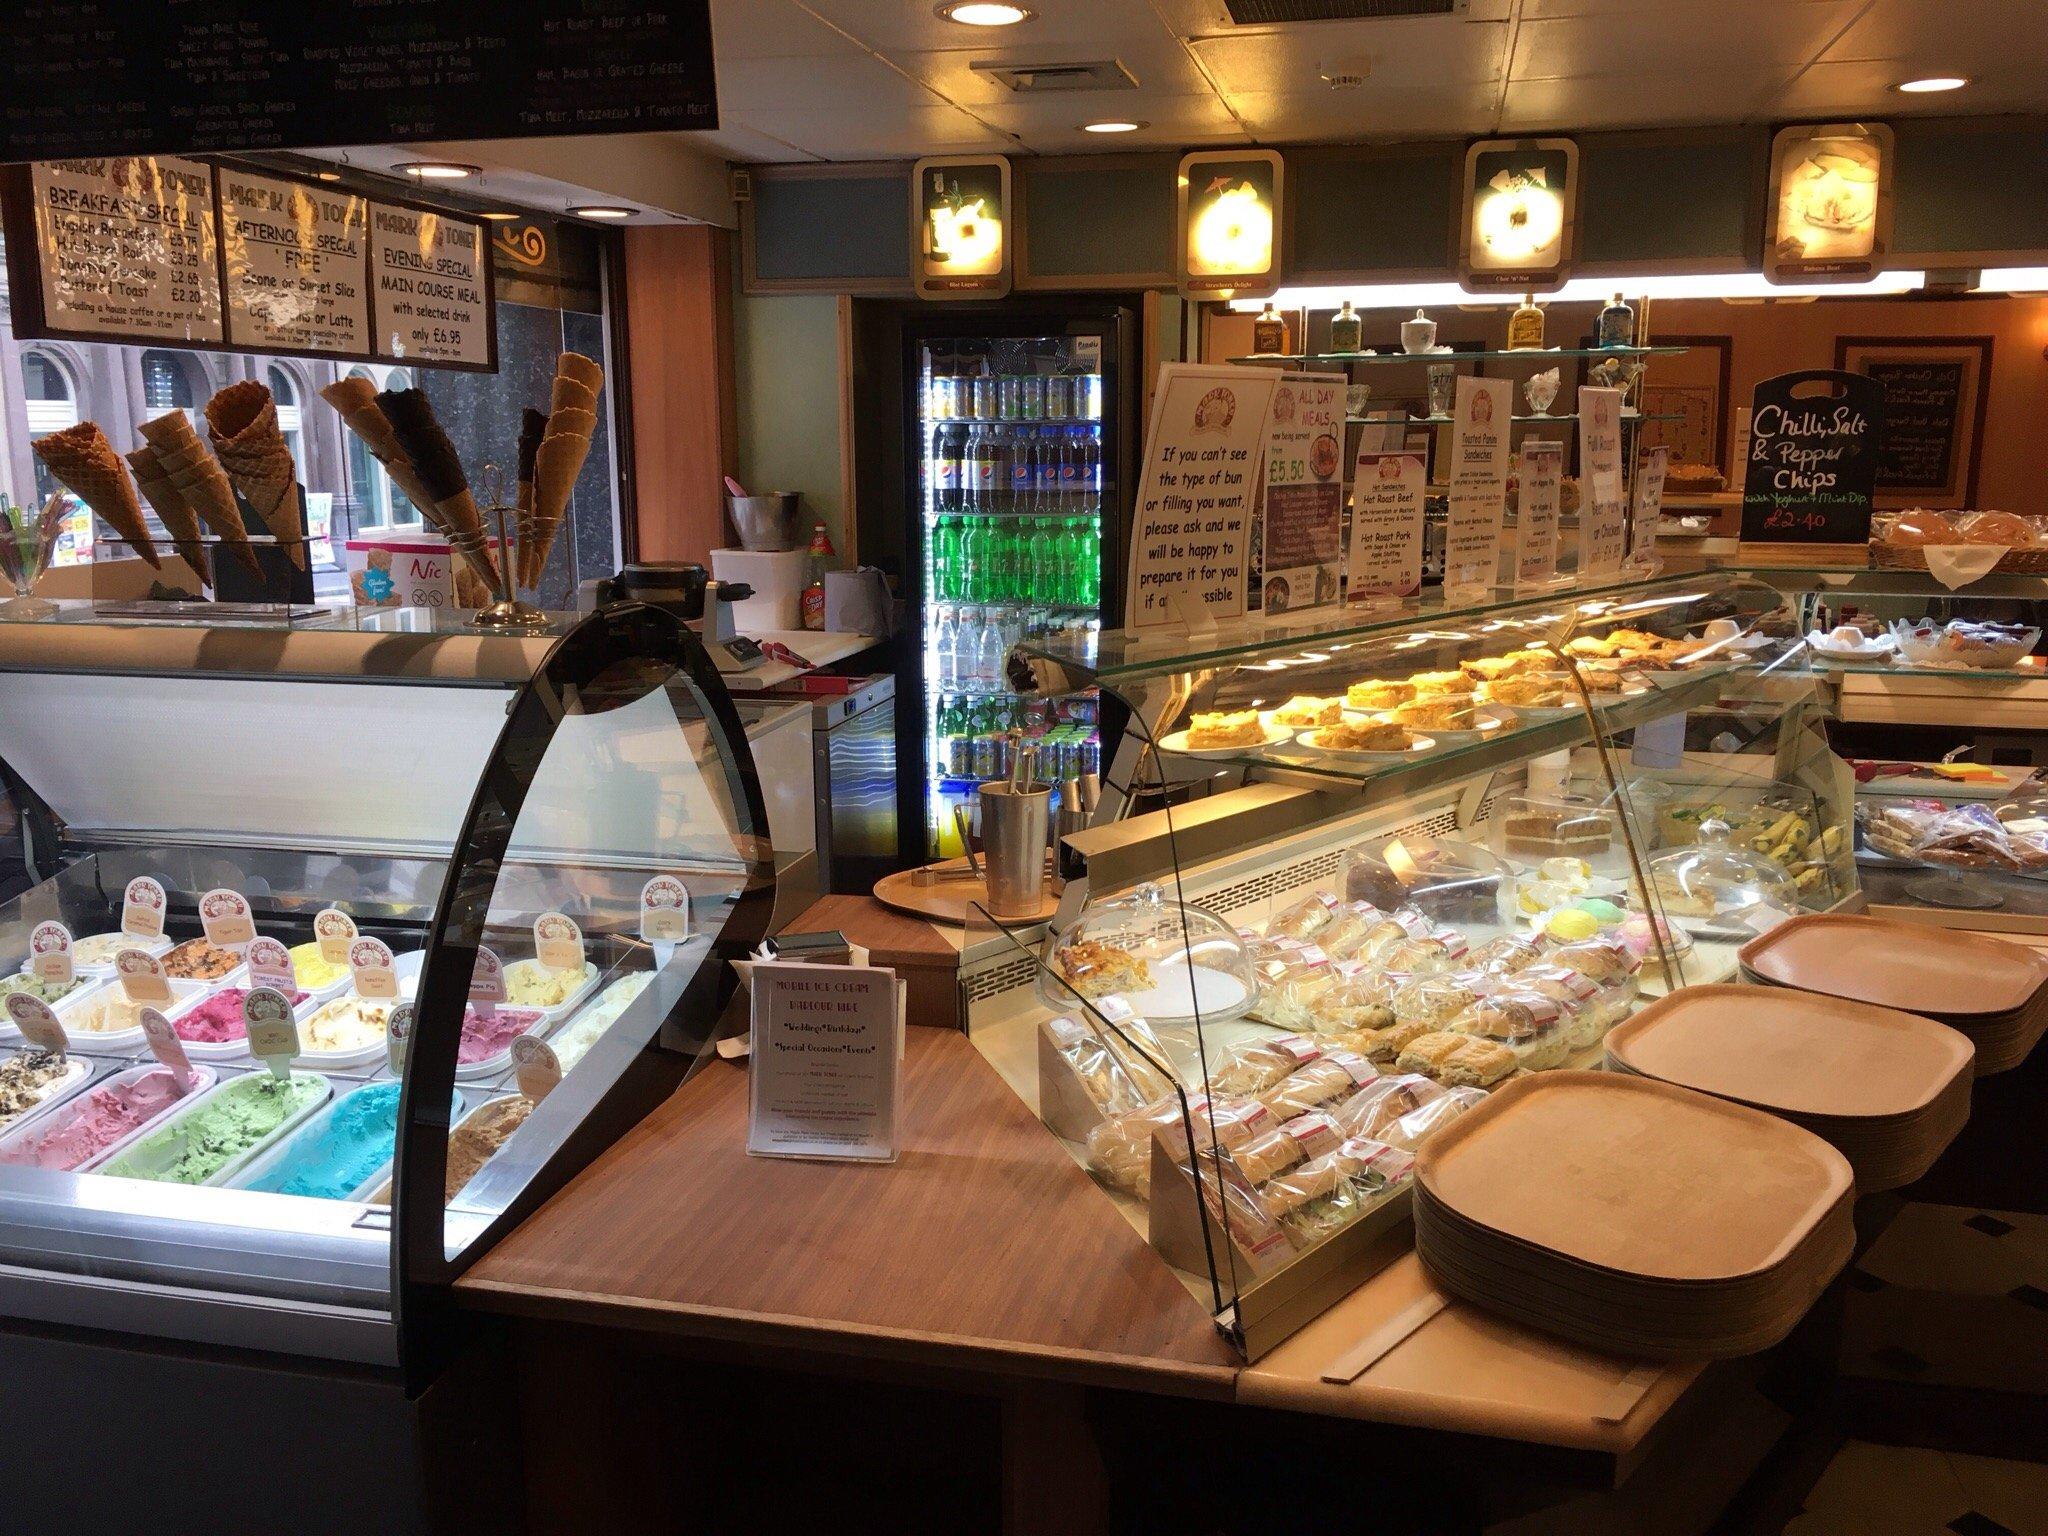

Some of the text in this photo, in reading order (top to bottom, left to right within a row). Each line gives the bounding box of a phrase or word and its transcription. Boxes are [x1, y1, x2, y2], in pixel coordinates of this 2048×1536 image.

[374, 210, 418, 238] MARK
[169, 250, 199, 268] £3.25
[383, 246, 473, 279] EVENING SPECIAL
[170, 269, 200, 285] £2.65
[1234, 280, 1252, 289] Delight
[119, 282, 149, 299] Toast
[171, 287, 201, 305] £2.20
[281, 278, 295, 289] or
[334, 282, 356, 298] Slice
[380, 274, 481, 305] MAIN COURSE MEAL
[129, 305, 154, 318] coffee
[314, 312, 354, 329] or Latte
[392, 301, 472, 323] with selected drink
[411, 326, 462, 344] only £6.95
[1299, 388, 1335, 407] ALL DAY
[1301, 411, 1331, 428] MEALS
[1753, 404, 1869, 439] Chilli, Salt
[1461, 432, 1498, 445] Toasted Panini
[1161, 445, 1248, 466] If you can't see
[1463, 448, 1492, 461] Sandwiches
[1751, 438, 1845, 472] & Pepper
[1159, 469, 1242, 490] the type of bun
[1269, 459, 1305, 484] £5.50
[1773, 469, 1837, 496] Chips
[1145, 494, 1245, 514] or filling you want,
[1363, 491, 1414, 505] Hot Roast Beef
[1818, 492, 1848, 504] Mint
[1144, 517, 1241, 540] please ask and we
[1361, 530, 1411, 544] Hot Roast Pork
[1148, 541, 1234, 560] will be happy to
[410, 557, 442, 580] Nic
[1140, 563, 1239, 590] prepare it for you
[805, 595, 824, 605] CRISP
[811, 601, 824, 612] DRY
[1144, 587, 1233, 610] if ssible
[776, 980, 871, 994] MOBILE ICE CREAM
[789, 1000, 859, 1013] PARLOUR HIRE
